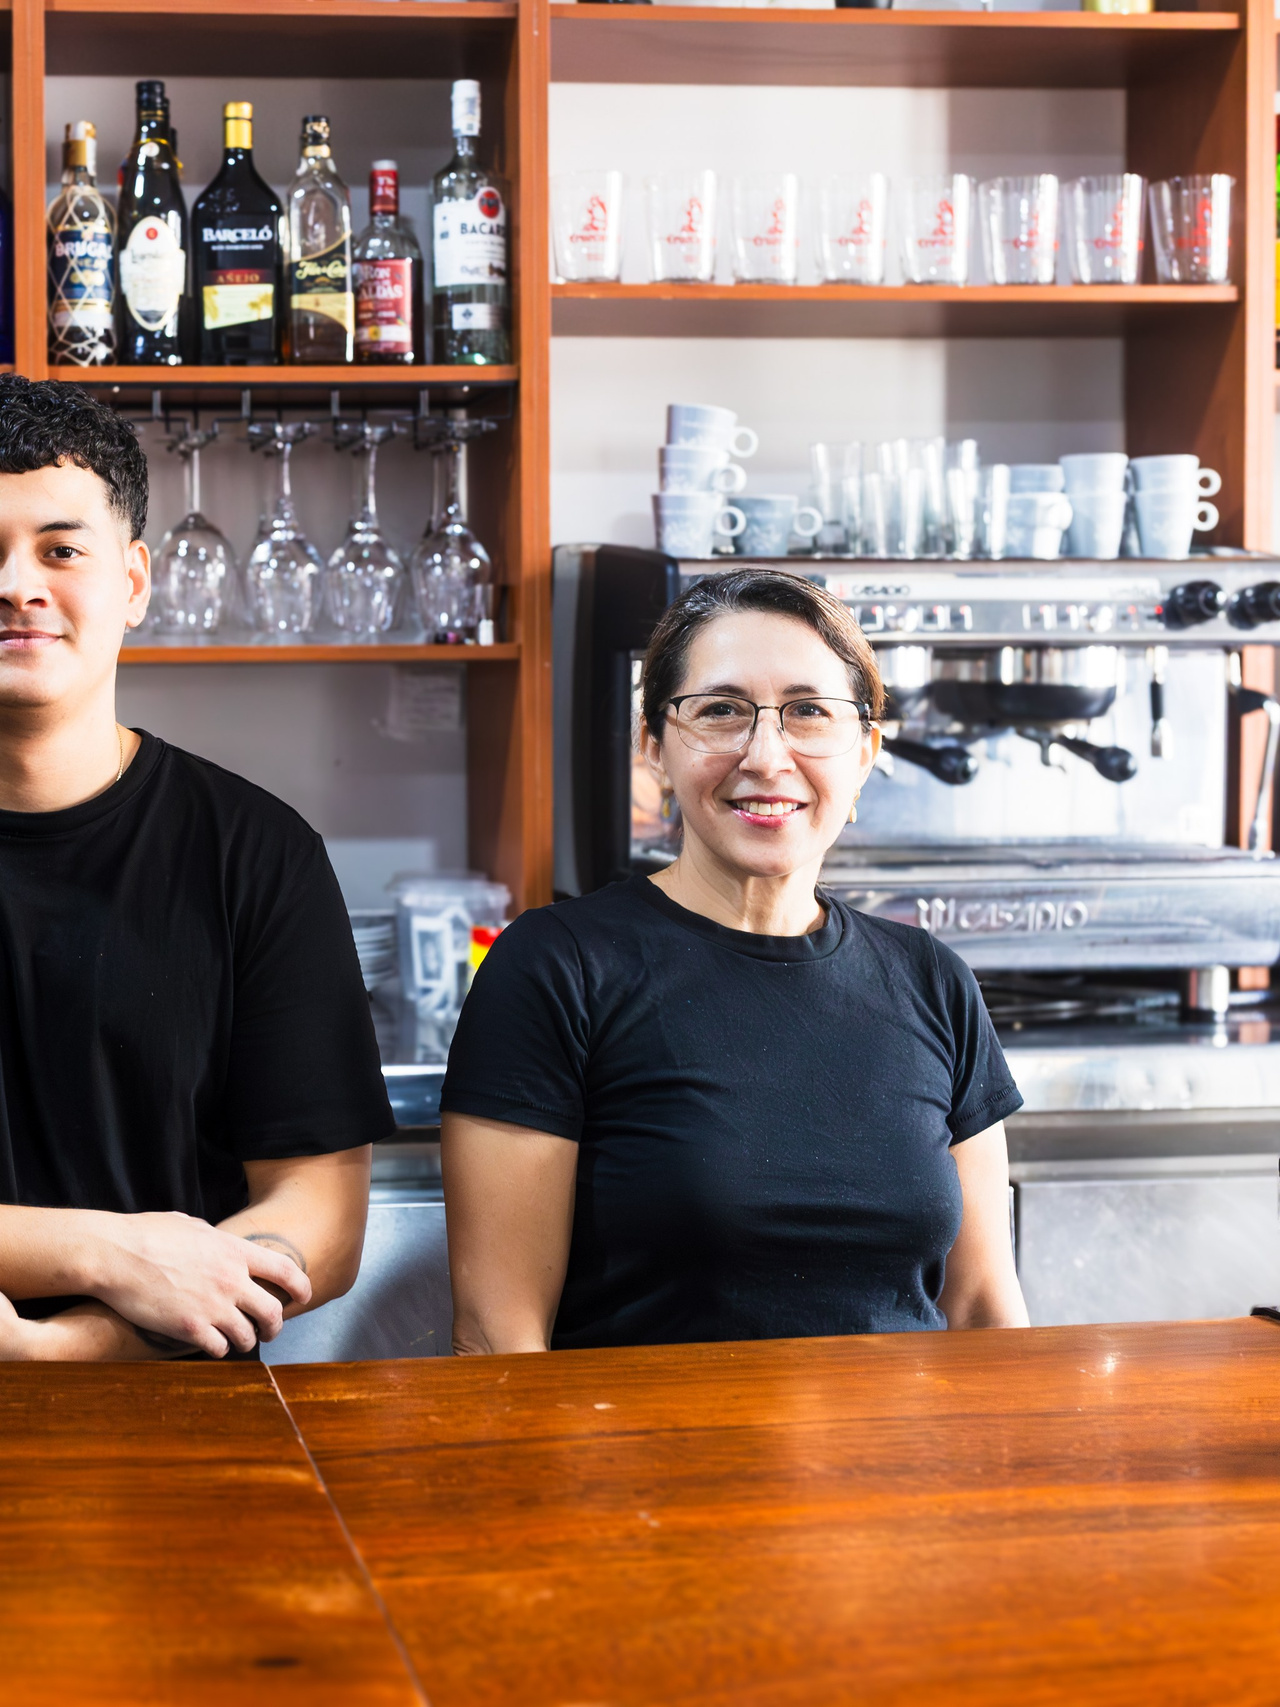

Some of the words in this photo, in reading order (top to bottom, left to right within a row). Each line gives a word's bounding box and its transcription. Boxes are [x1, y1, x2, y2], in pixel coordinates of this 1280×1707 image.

[203, 224, 272, 242] BARCELÓ
[216, 272, 260, 284] AÑEJO
[959, 900, 1090, 932] CASADIO
